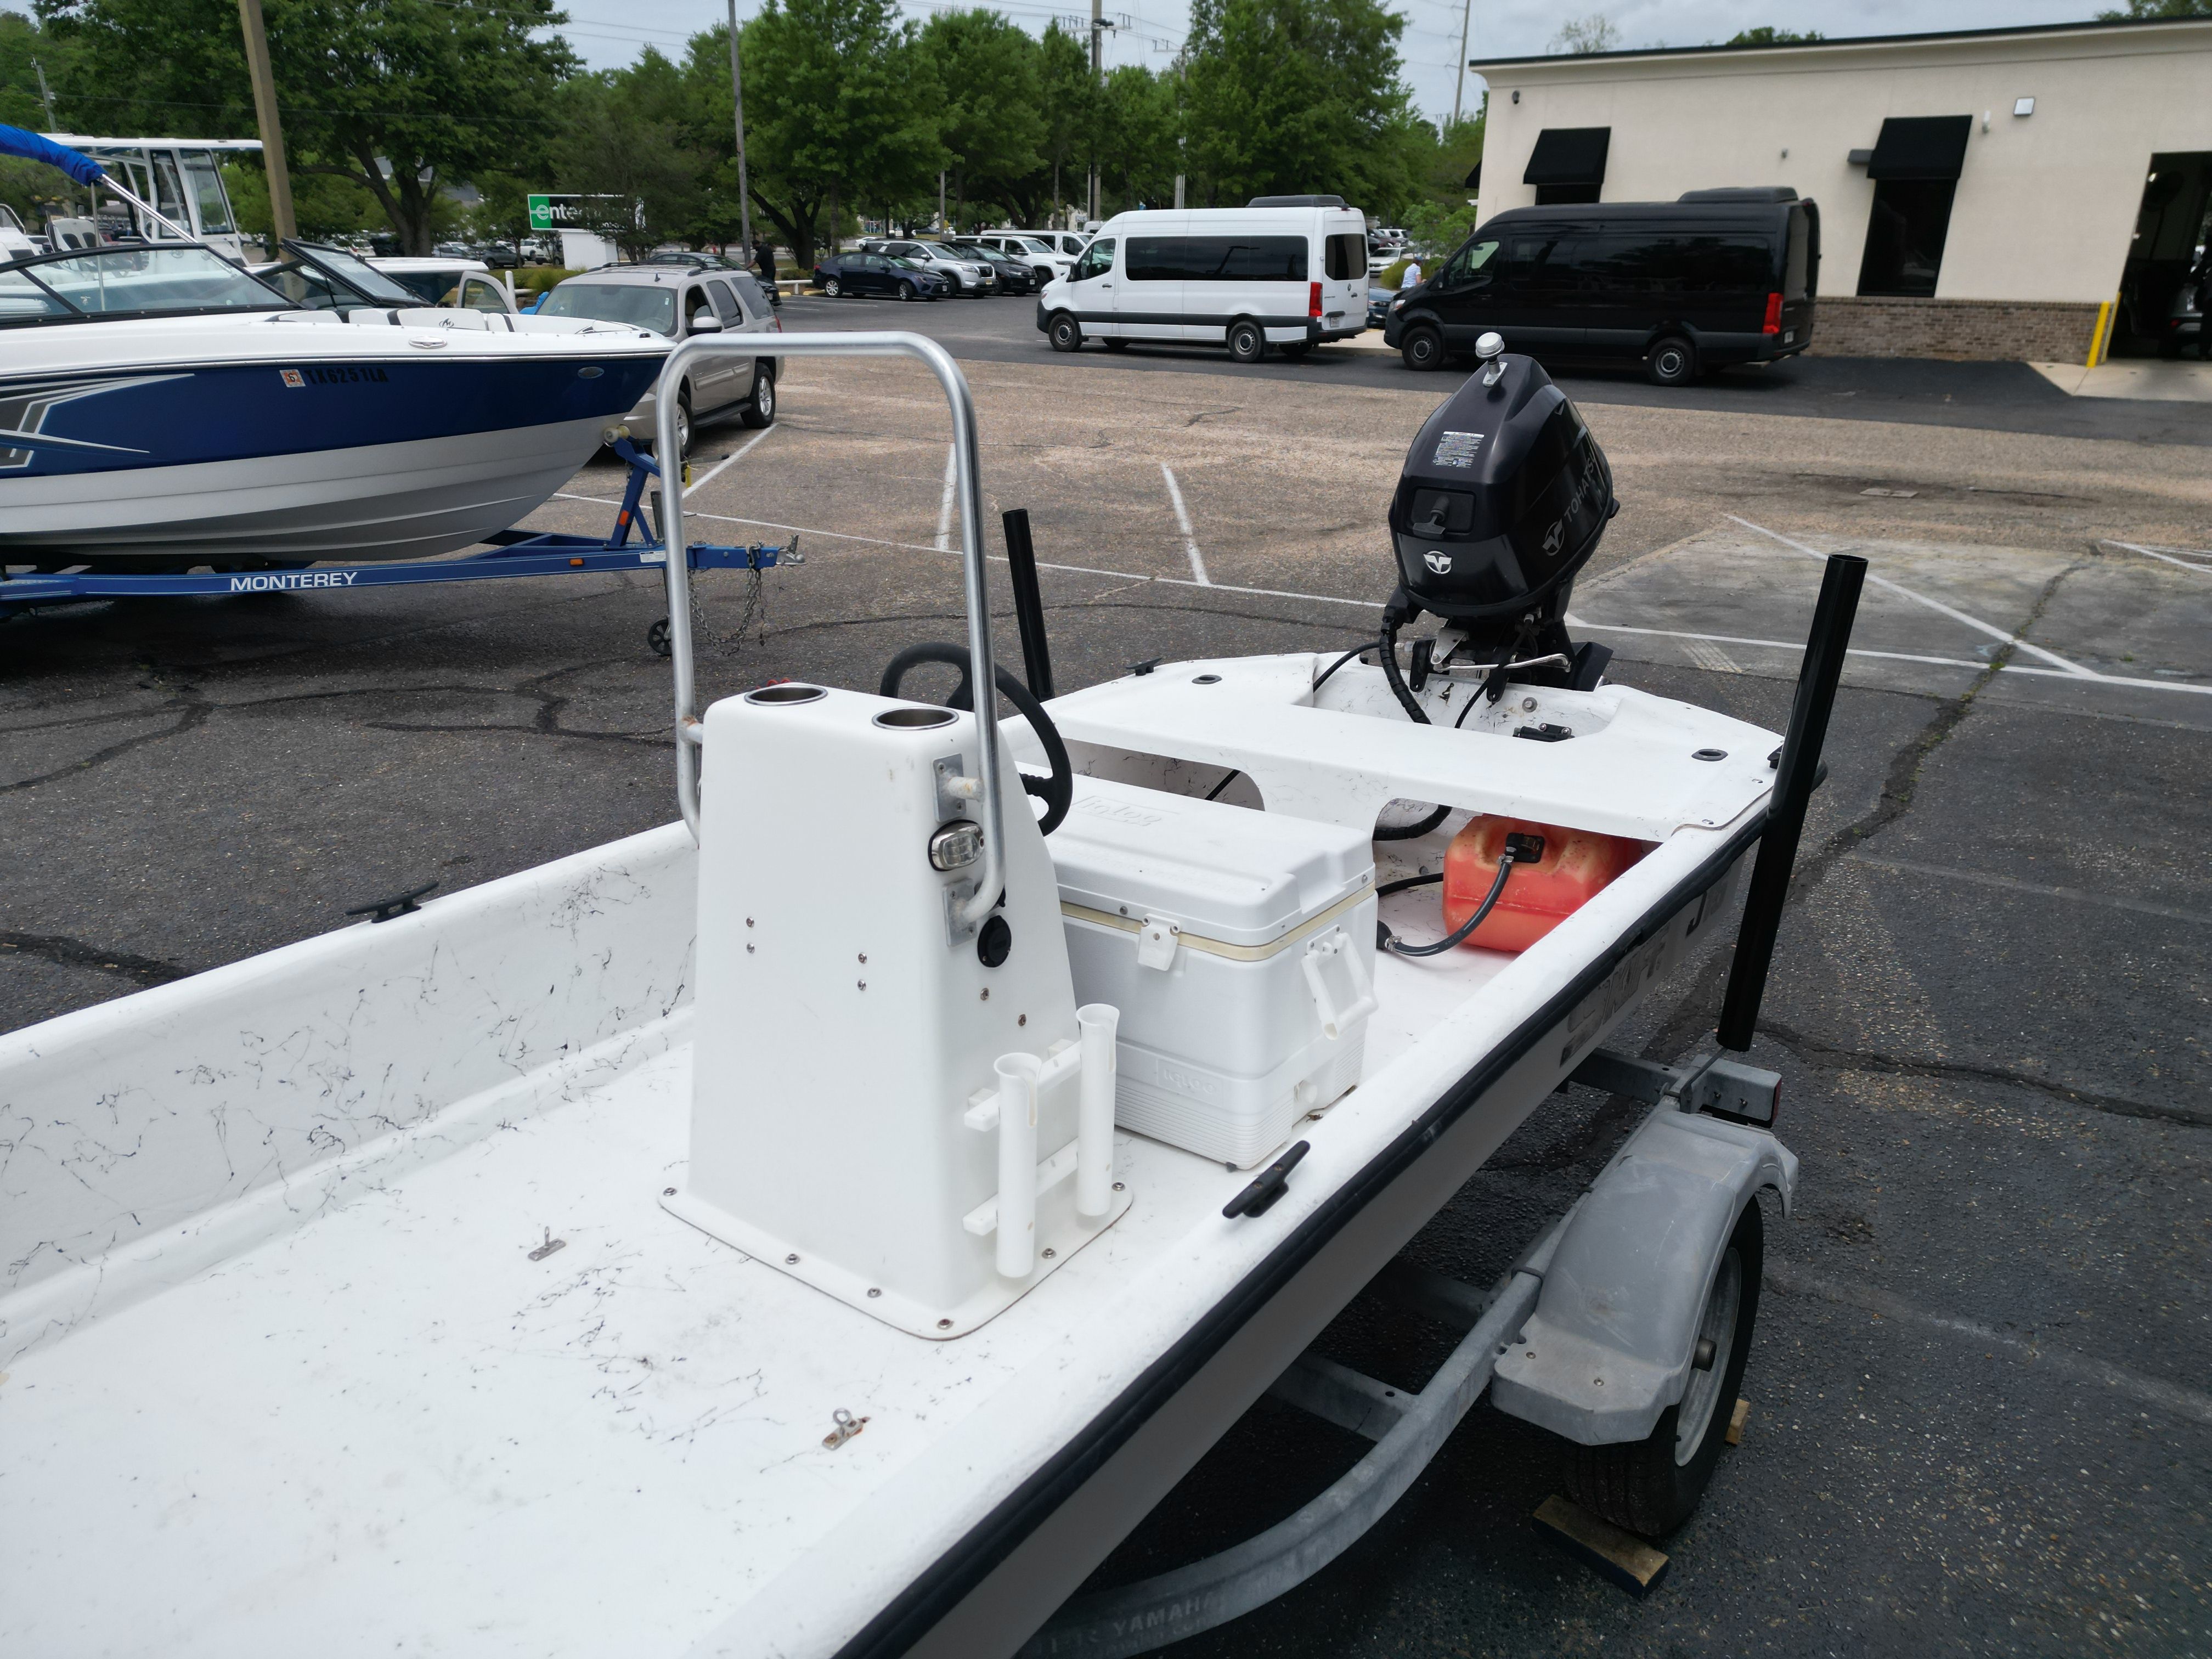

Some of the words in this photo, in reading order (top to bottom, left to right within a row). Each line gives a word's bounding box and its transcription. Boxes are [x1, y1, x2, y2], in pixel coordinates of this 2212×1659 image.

[288, 373, 296, 382] 6
[304, 368, 390, 385] TX6251LA
[230, 572, 358, 591] MONTEREY
